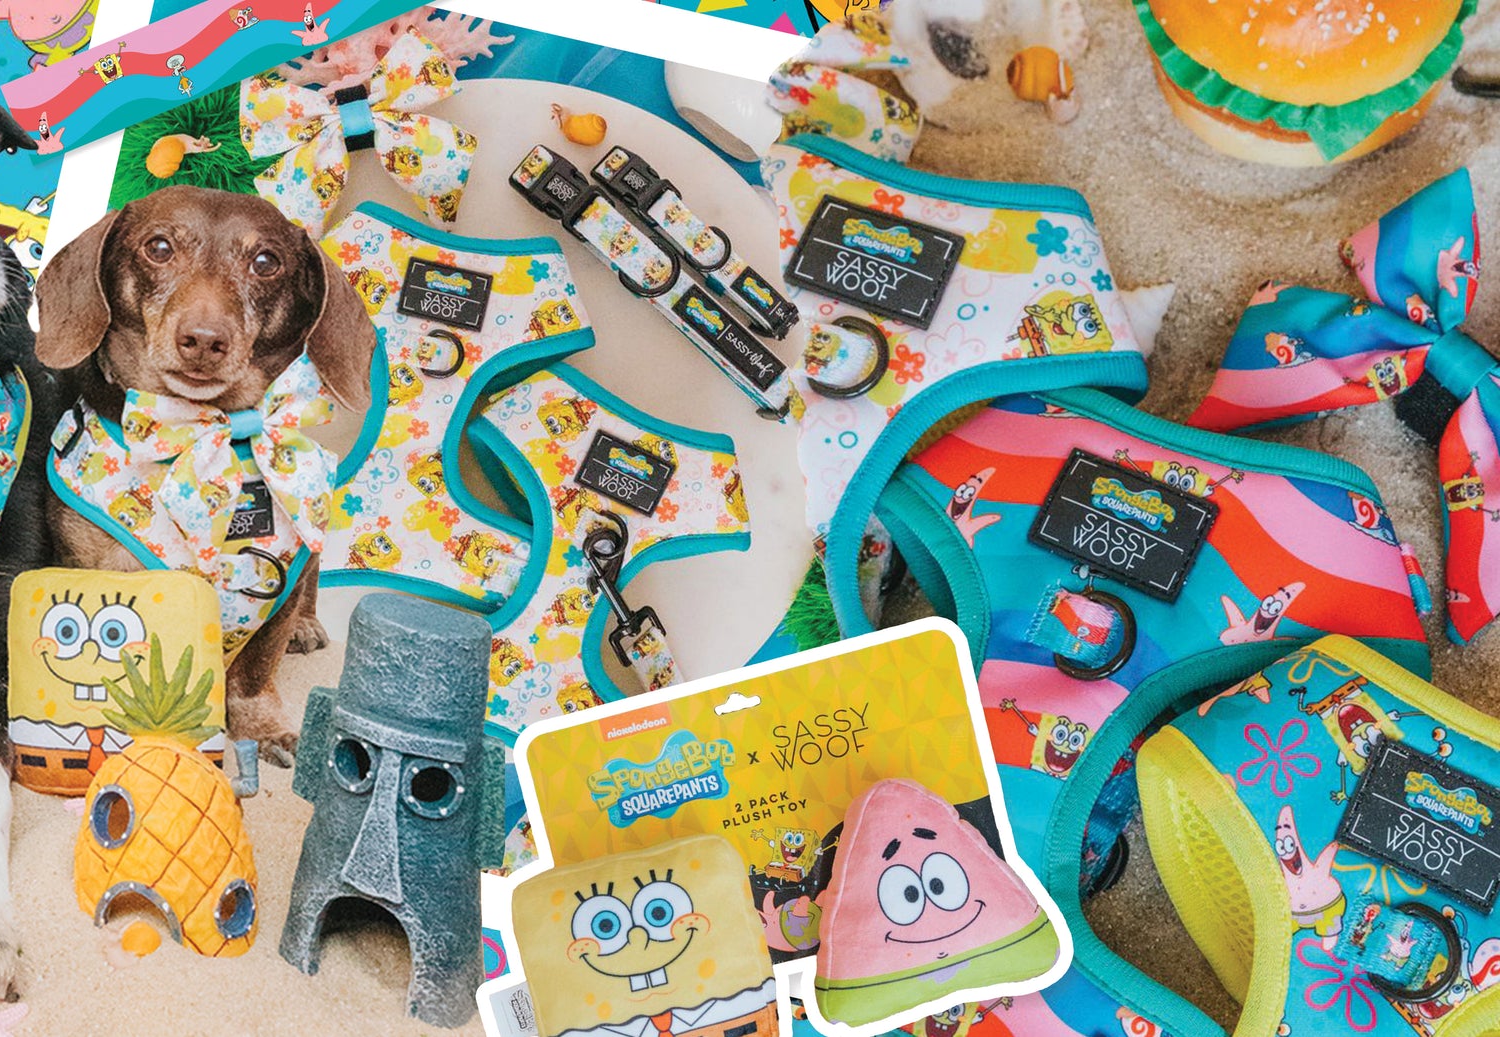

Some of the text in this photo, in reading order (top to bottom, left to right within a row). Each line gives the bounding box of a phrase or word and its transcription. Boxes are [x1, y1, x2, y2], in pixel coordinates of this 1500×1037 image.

[827, 264, 897, 301] WOOF
[833, 251, 908, 287] SASSY
[420, 299, 461, 318] WOOF
[424, 292, 466, 312] SASSY
[726, 332, 752, 356] SASSY
[598, 475, 638, 500] WOOF
[604, 468, 644, 495] SASSY
[227, 523, 253, 535] OOF
[233, 513, 255, 525] SSY
[1081, 513, 1158, 557] SASSY
[1073, 526, 1146, 570] WOOF
[607, 717, 667, 740] nickelodeon
[773, 702, 869, 748] SASSY
[770, 727, 869, 772] WOOF
[587, 740, 736, 812] SpongeBob
[621, 775, 719, 817] SQUAREPANTS
[734, 790, 791, 813] 2 PACK
[1415, 794, 1475, 828] SQUAREPANTS
[722, 799, 808, 830] PLUSH TOY
[1386, 827, 1463, 877] WOOF
[1395, 813, 1476, 863] SASSY
